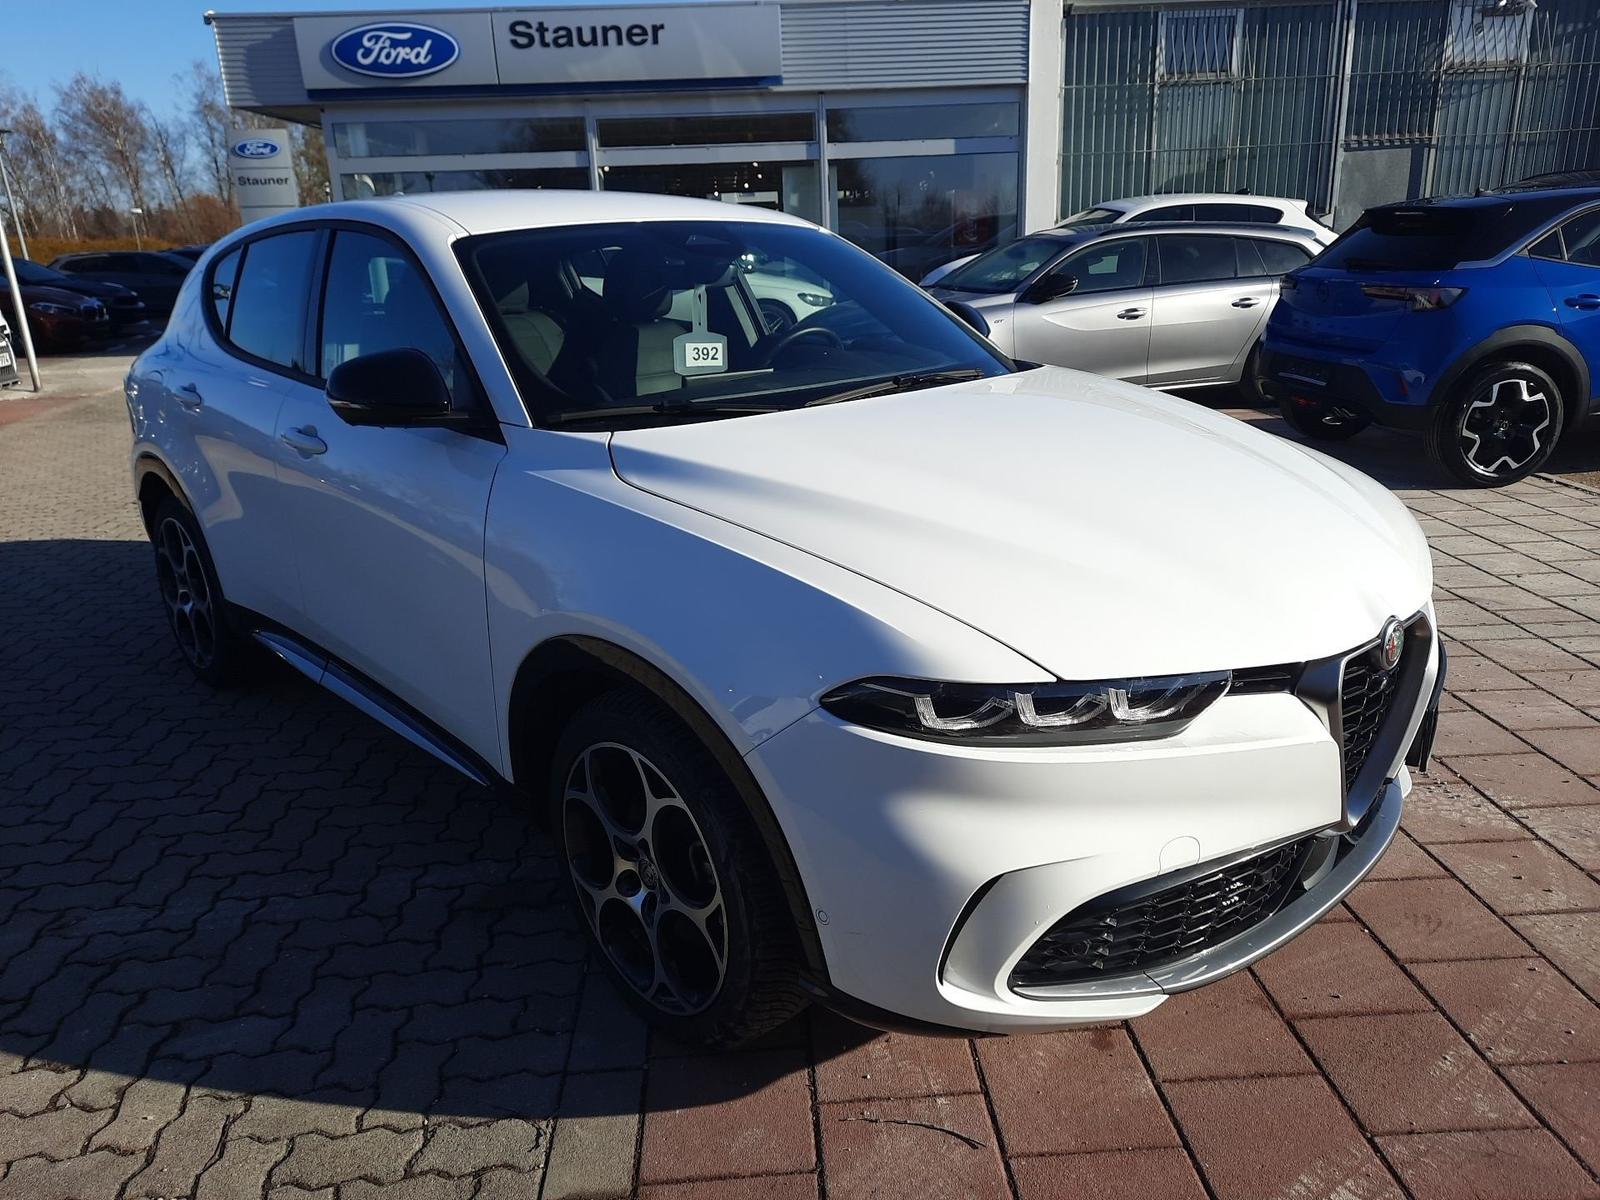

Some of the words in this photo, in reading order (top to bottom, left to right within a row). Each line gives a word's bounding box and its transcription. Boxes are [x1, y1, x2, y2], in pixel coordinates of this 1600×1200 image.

[509, 20, 665, 49] Stauner
[357, 30, 432, 65] Ford
[244, 142, 272, 155] Ford
[237, 176, 289, 186] Stauner
[692, 346, 719, 361] 392
